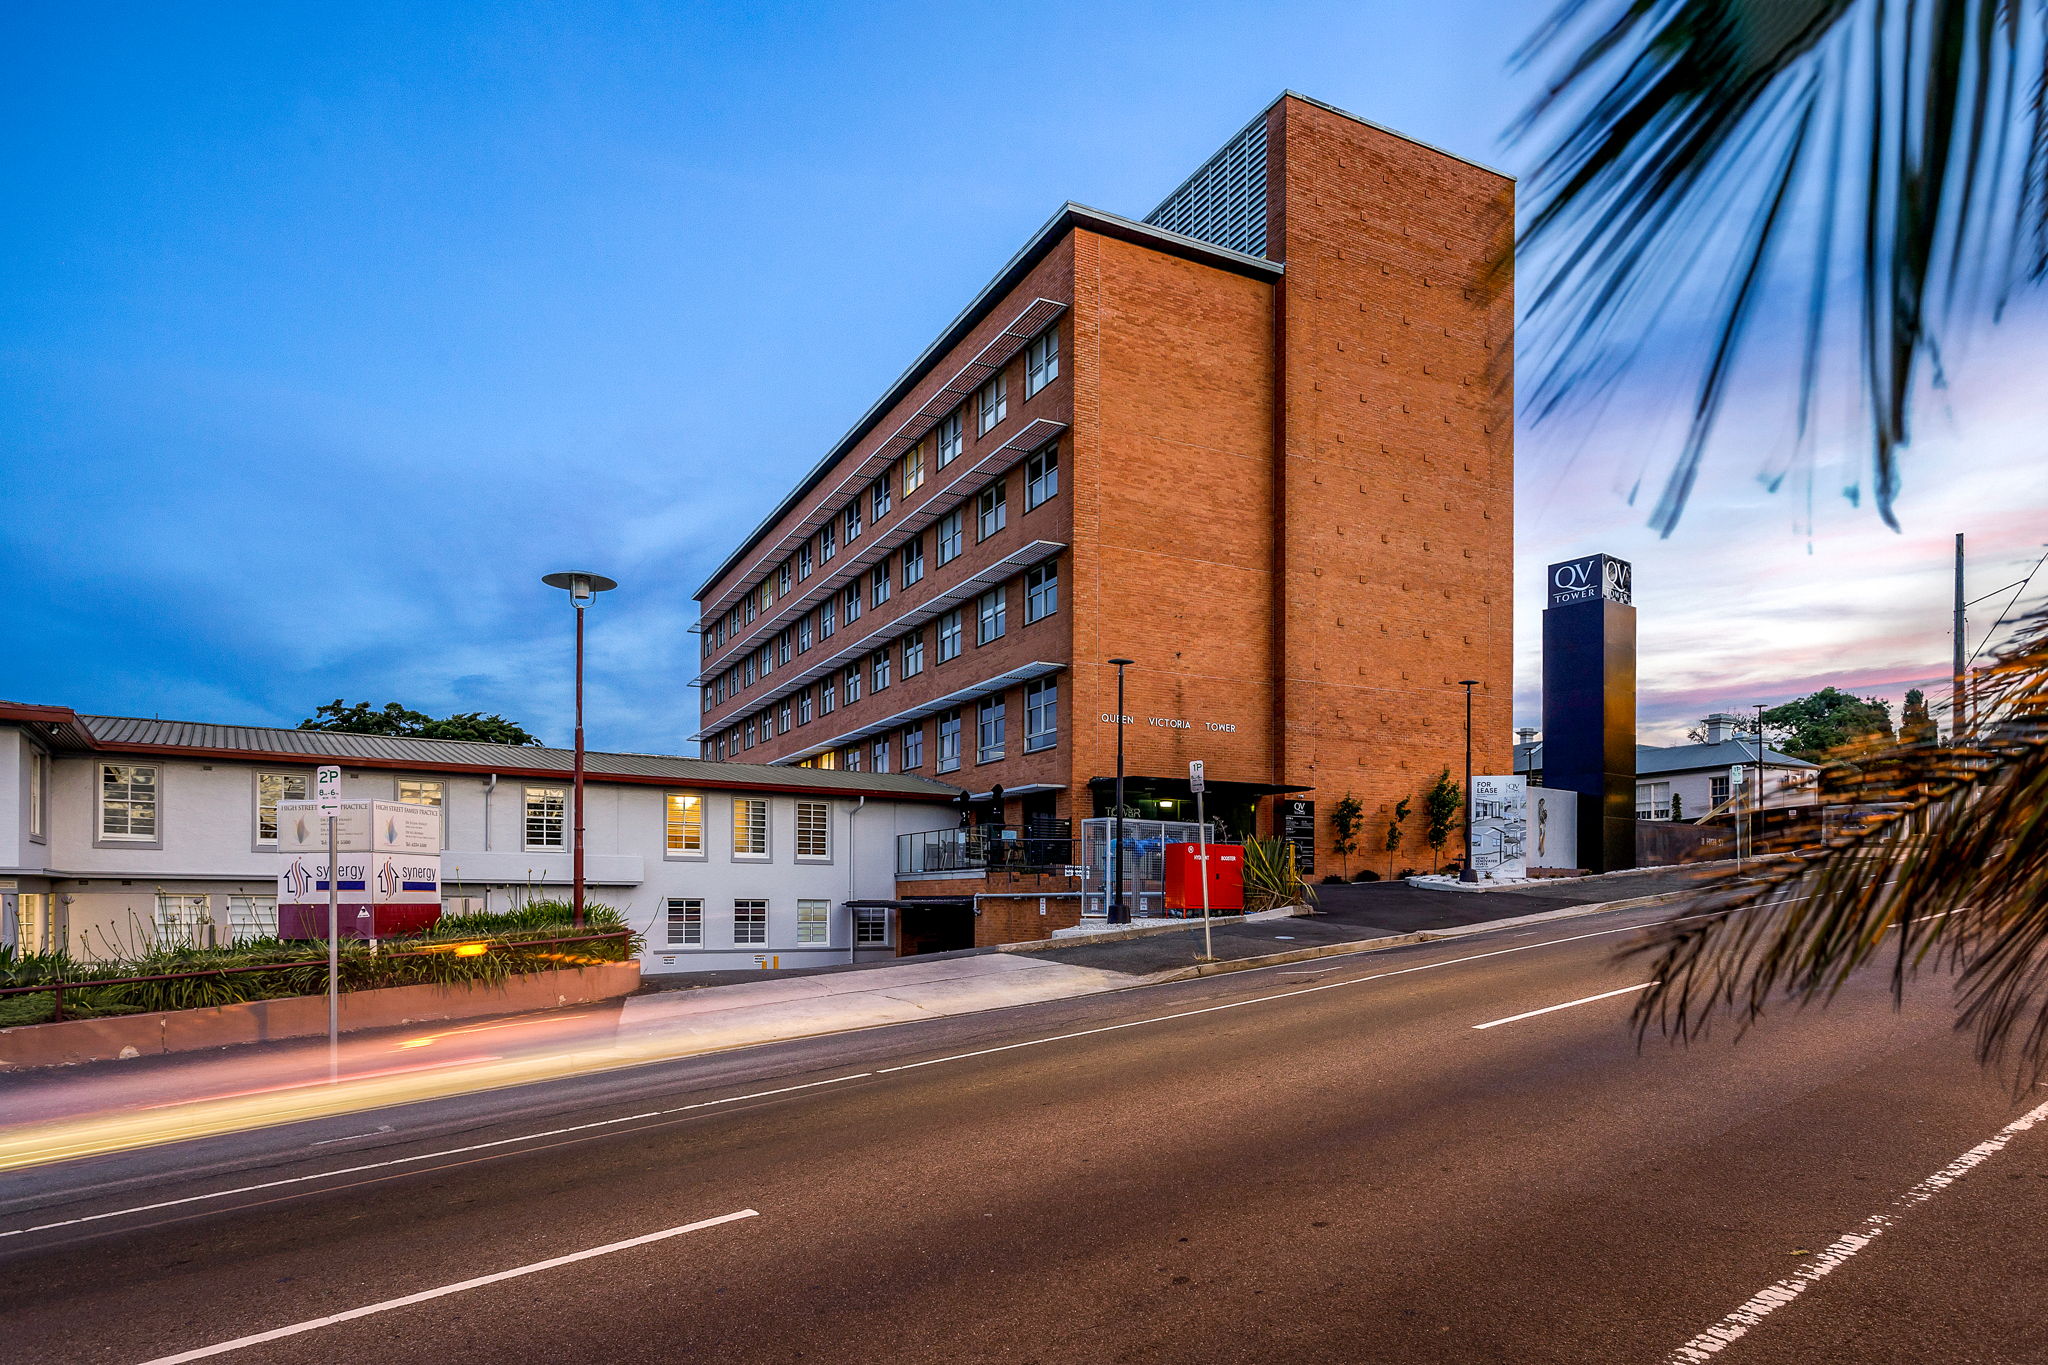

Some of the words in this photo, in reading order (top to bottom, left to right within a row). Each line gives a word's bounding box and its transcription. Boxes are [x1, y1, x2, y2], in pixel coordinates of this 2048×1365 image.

[1555, 560, 1595, 591] QV
[1606, 561, 1628, 592] QV
[1554, 589, 1595, 603] TOWER
[1148, 717, 1191, 729] VICTORIA
[1205, 722, 1236, 733] TOWER
[319, 770, 338, 783] 2P
[389, 805, 403, 813] STREET
[1294, 802, 1305, 812] QV
[316, 865, 365, 880] syergy
[402, 865, 436, 881] synergy
